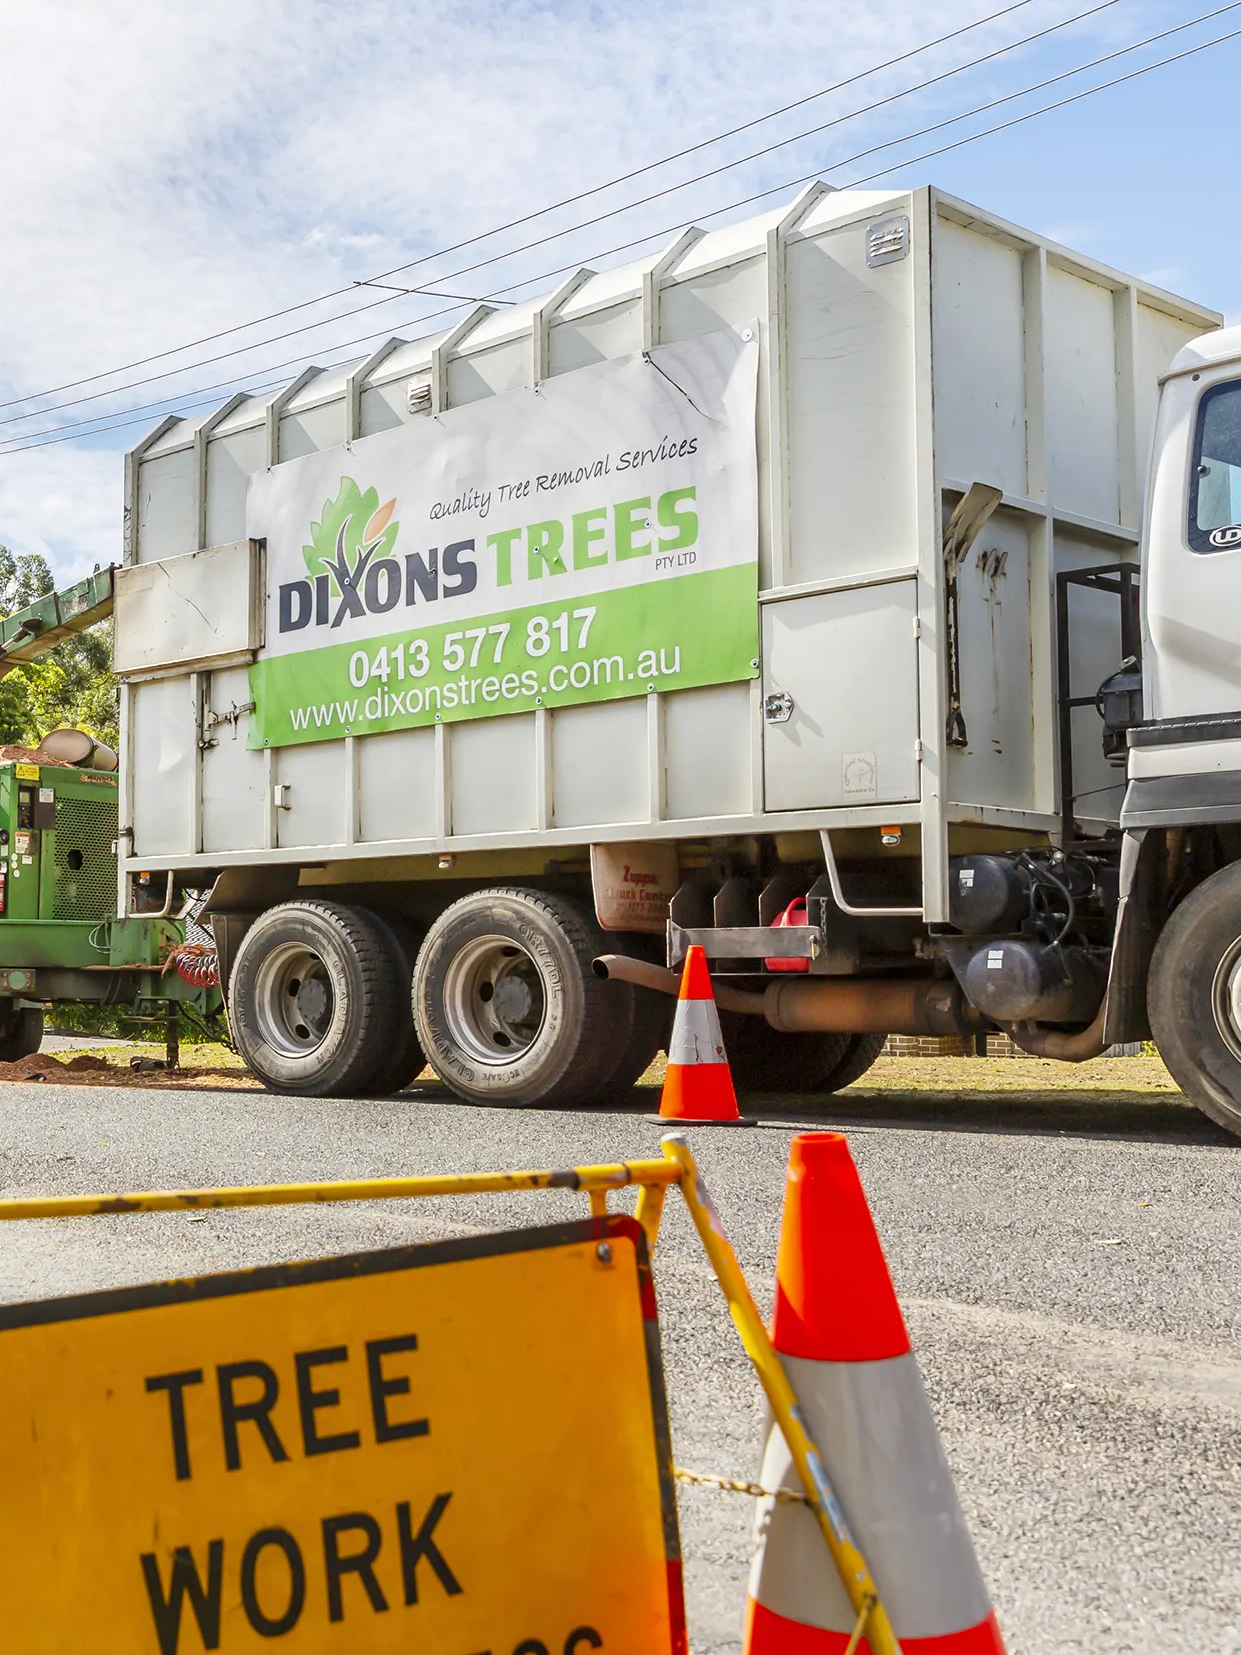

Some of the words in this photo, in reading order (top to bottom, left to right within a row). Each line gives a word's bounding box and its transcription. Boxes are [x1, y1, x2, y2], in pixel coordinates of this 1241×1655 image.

[429, 487, 492, 520] Quality
[498, 479, 530, 503] Tree
[536, 454, 611, 493] Removal
[615, 435, 698, 471] Services
[278, 520, 478, 634] DIXONS
[486, 485, 699, 588] TREES
[655, 558, 675, 571] PTY
[677, 551, 697, 567] LTD
[1215, 528, 1241, 543] UD
[290, 645, 681, 731] www.dixonstrees.com.au
[349, 638, 430, 688] 0413
[442, 622, 511, 673] 577
[525, 606, 598, 658] 817
[144, 1333, 431, 1482] TREE
[139, 1491, 464, 1655] WORK
